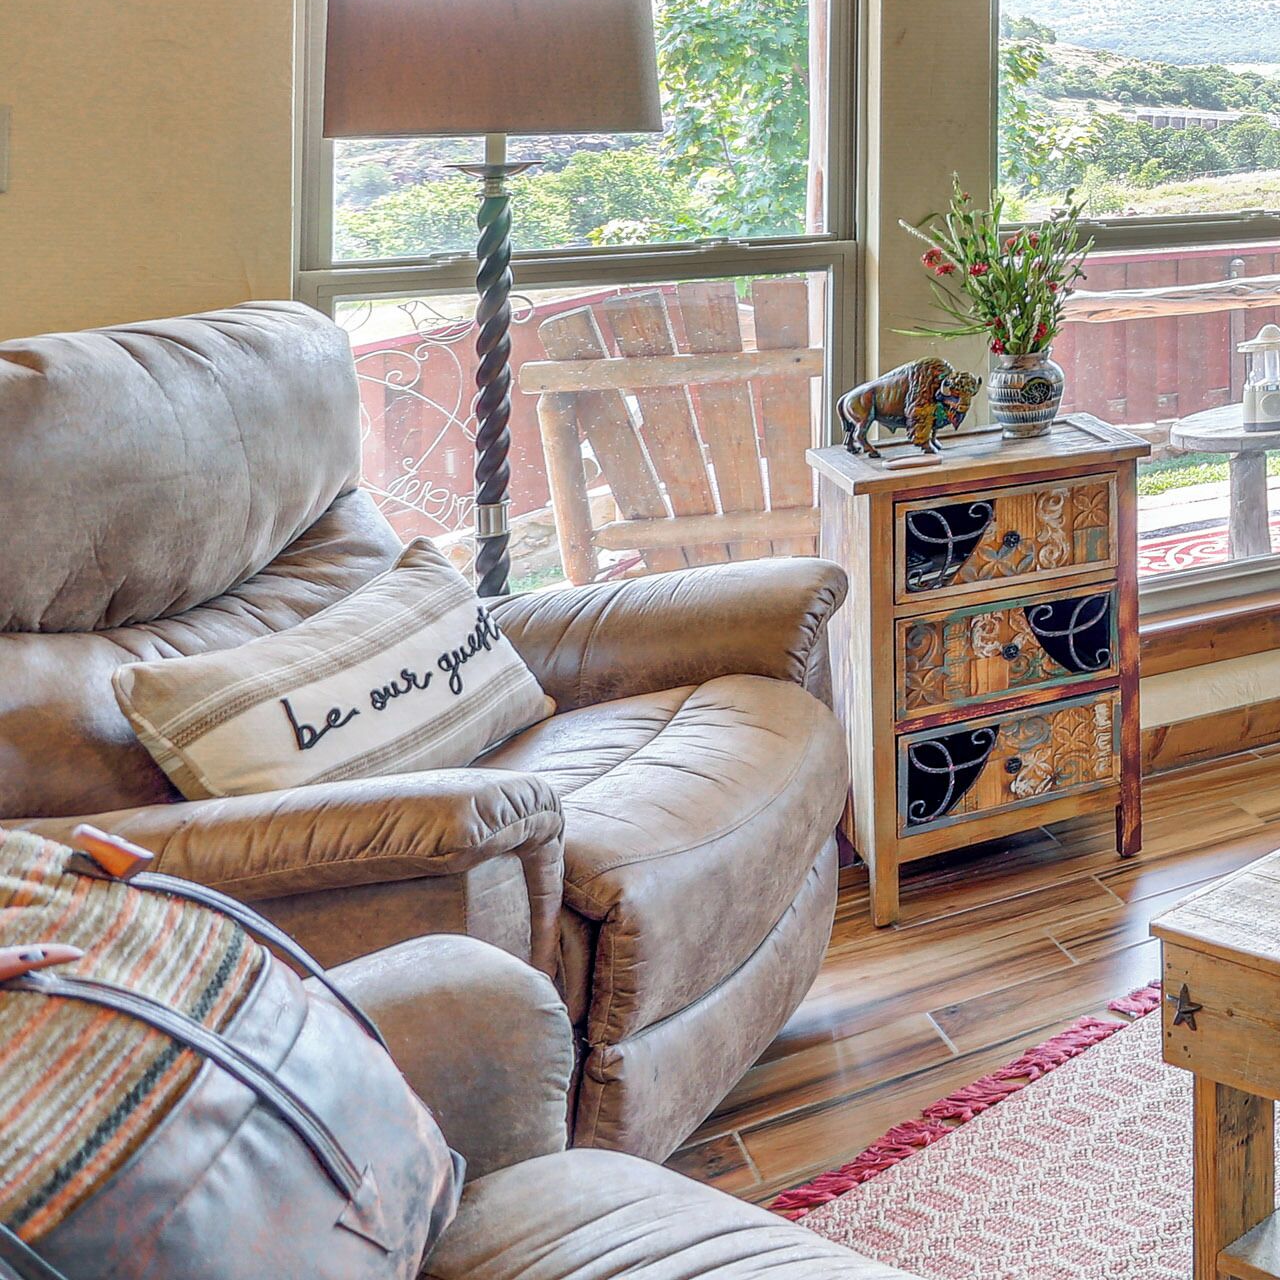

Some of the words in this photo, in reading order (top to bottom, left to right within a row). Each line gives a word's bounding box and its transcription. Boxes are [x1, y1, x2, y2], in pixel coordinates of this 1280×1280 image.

[280, 697, 360, 750] be
[370, 668, 433, 710] our
[437, 605, 500, 695] guest
